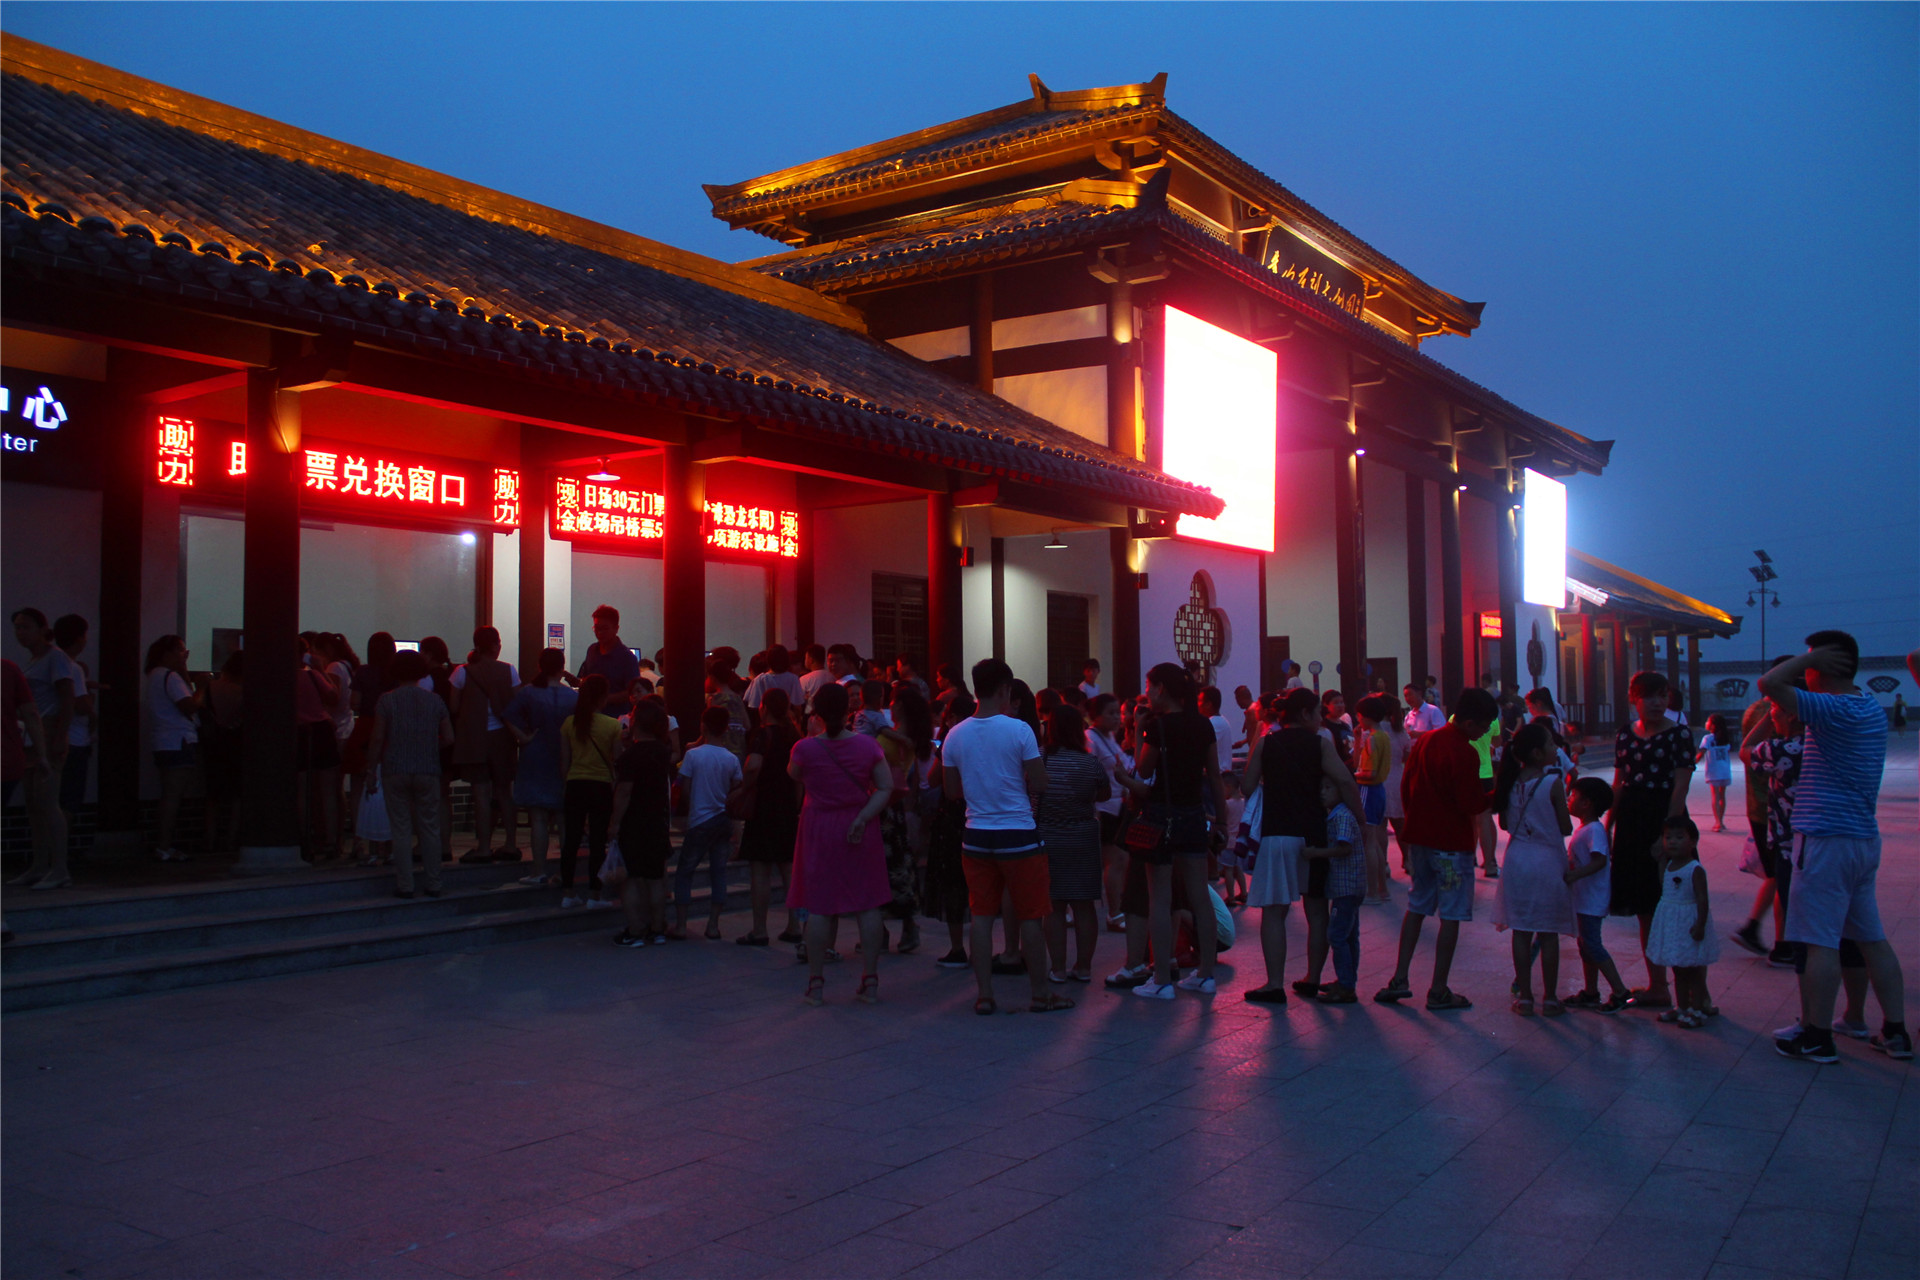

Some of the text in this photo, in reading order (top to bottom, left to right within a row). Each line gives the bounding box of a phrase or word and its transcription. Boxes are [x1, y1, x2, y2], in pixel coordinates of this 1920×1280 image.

[0, 386, 68, 429] 心
[304, 449, 465, 507] 票兑换窗口
